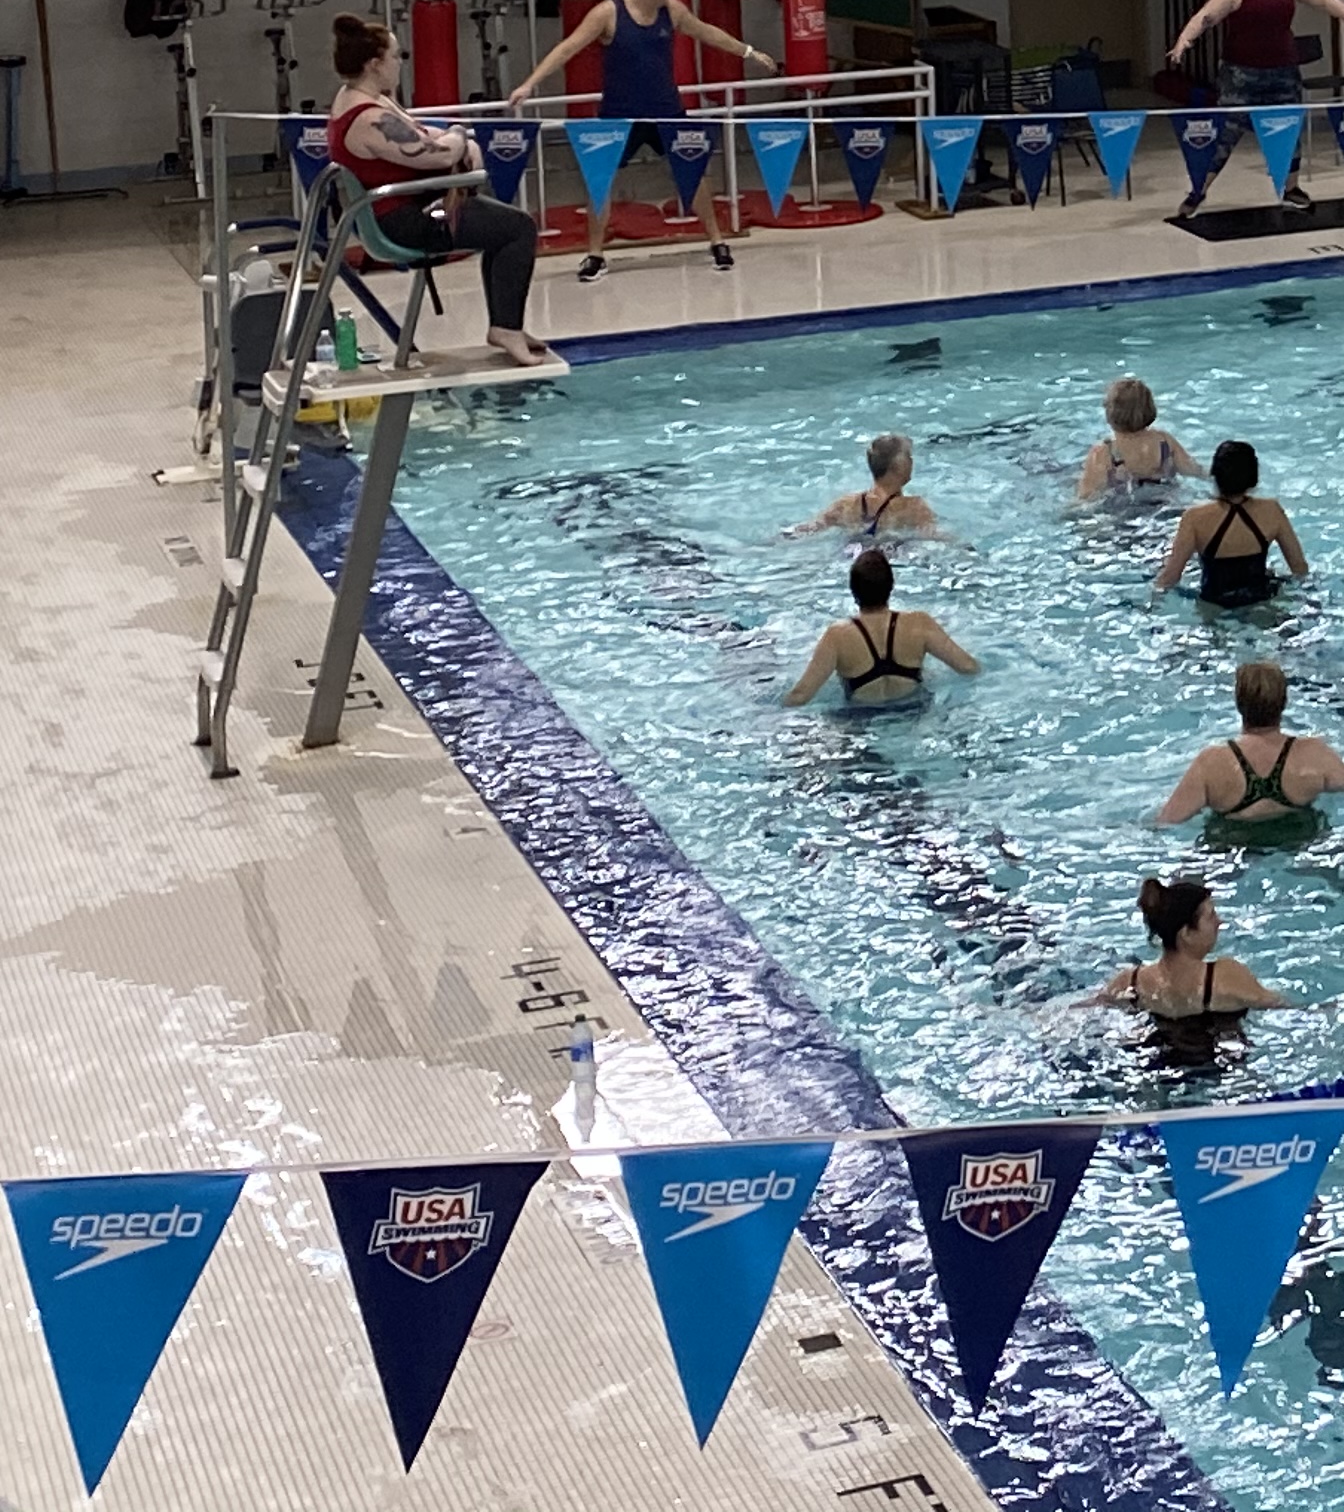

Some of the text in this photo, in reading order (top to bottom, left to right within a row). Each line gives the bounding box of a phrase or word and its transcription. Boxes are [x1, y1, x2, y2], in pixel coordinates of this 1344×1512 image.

[1195, 1134, 1316, 1176] speedo
[969, 1162, 1029, 1188] USA
[659, 1170, 796, 1212] speedo
[954, 1184, 1042, 1205] SWIMMING
[400, 1197, 466, 1225] USA
[49, 1204, 203, 1249] speedo
[381, 1220, 483, 1243] SWIMMING
